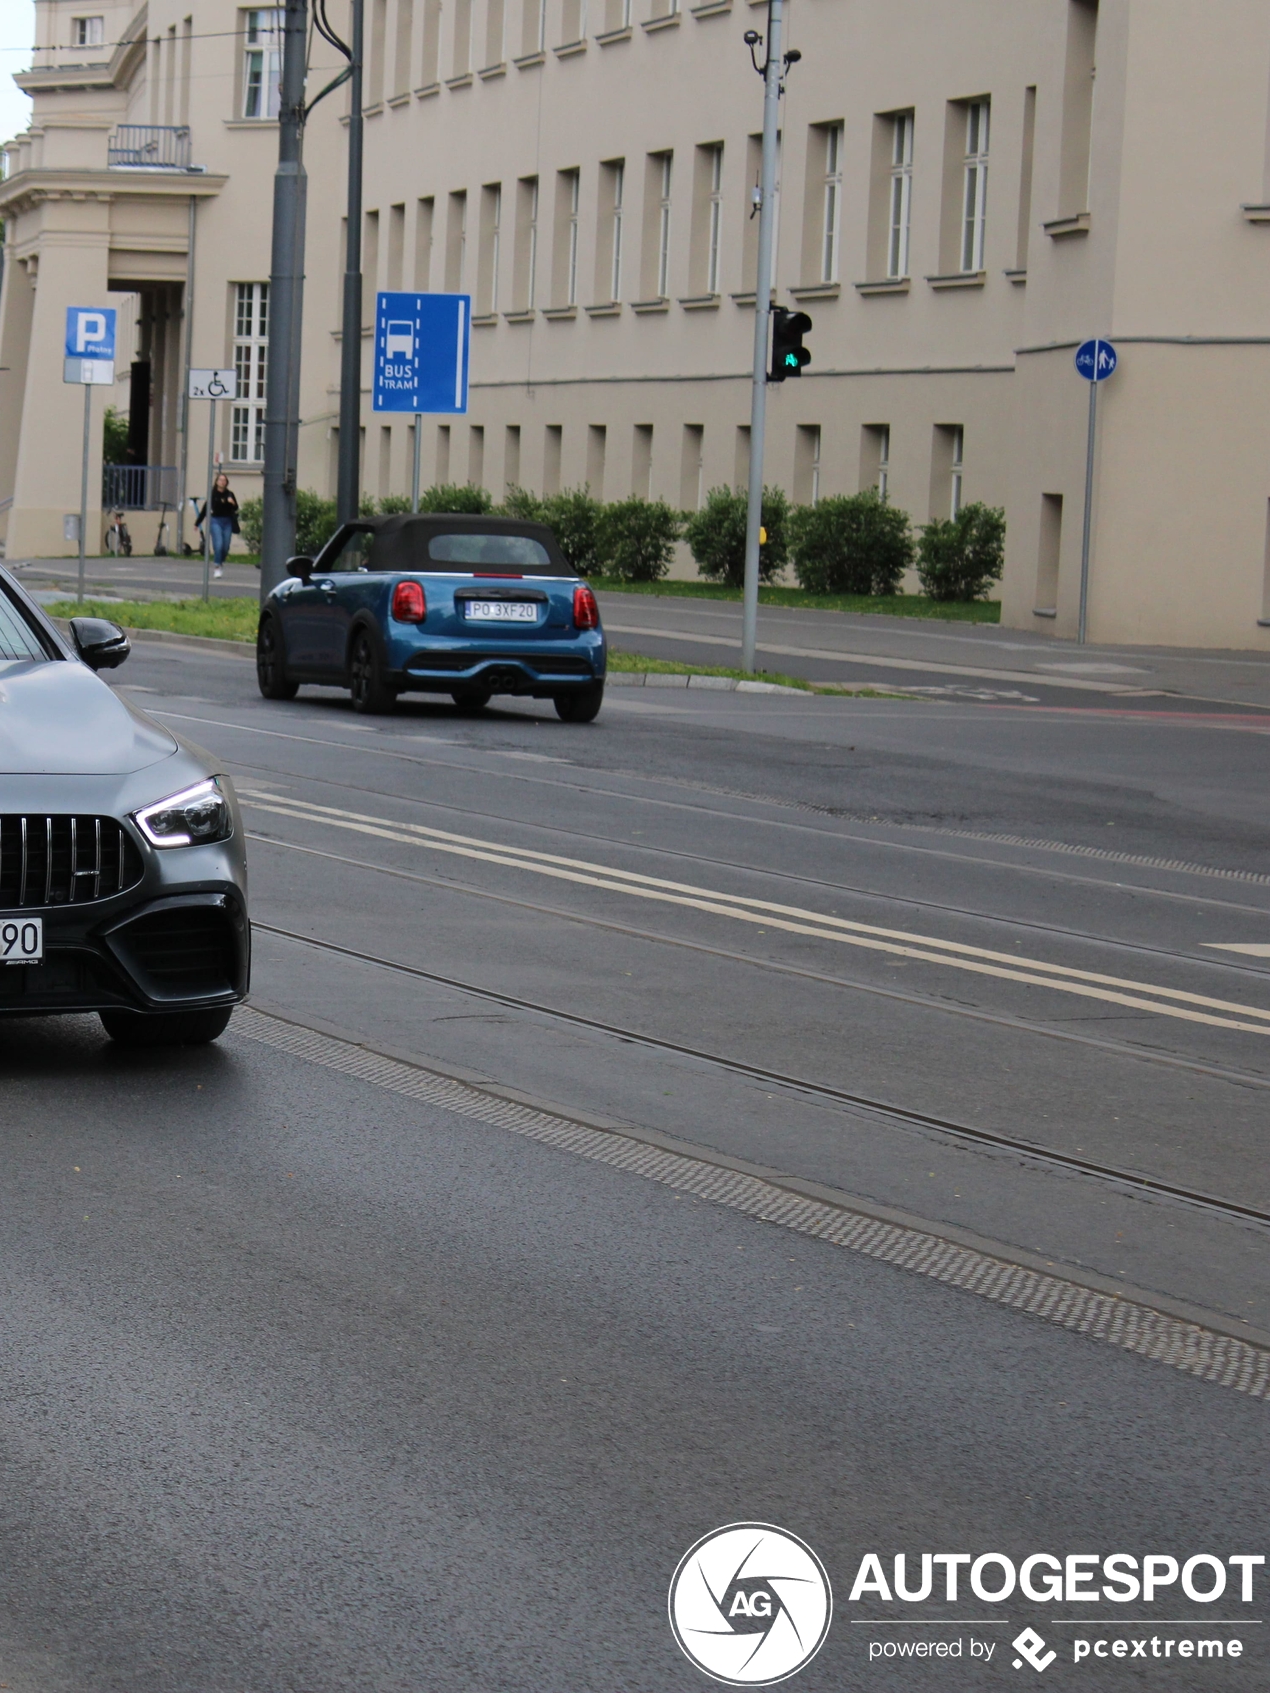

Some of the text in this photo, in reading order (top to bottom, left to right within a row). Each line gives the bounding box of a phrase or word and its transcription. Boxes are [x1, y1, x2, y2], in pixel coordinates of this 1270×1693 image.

[76, 312, 106, 352] P
[385, 364, 412, 378] BUS
[193, 386, 205, 396] 2x
[384, 380, 413, 390] TRAM
[473, 603, 490, 616] PO
[495, 604, 533, 617] 3XF20
